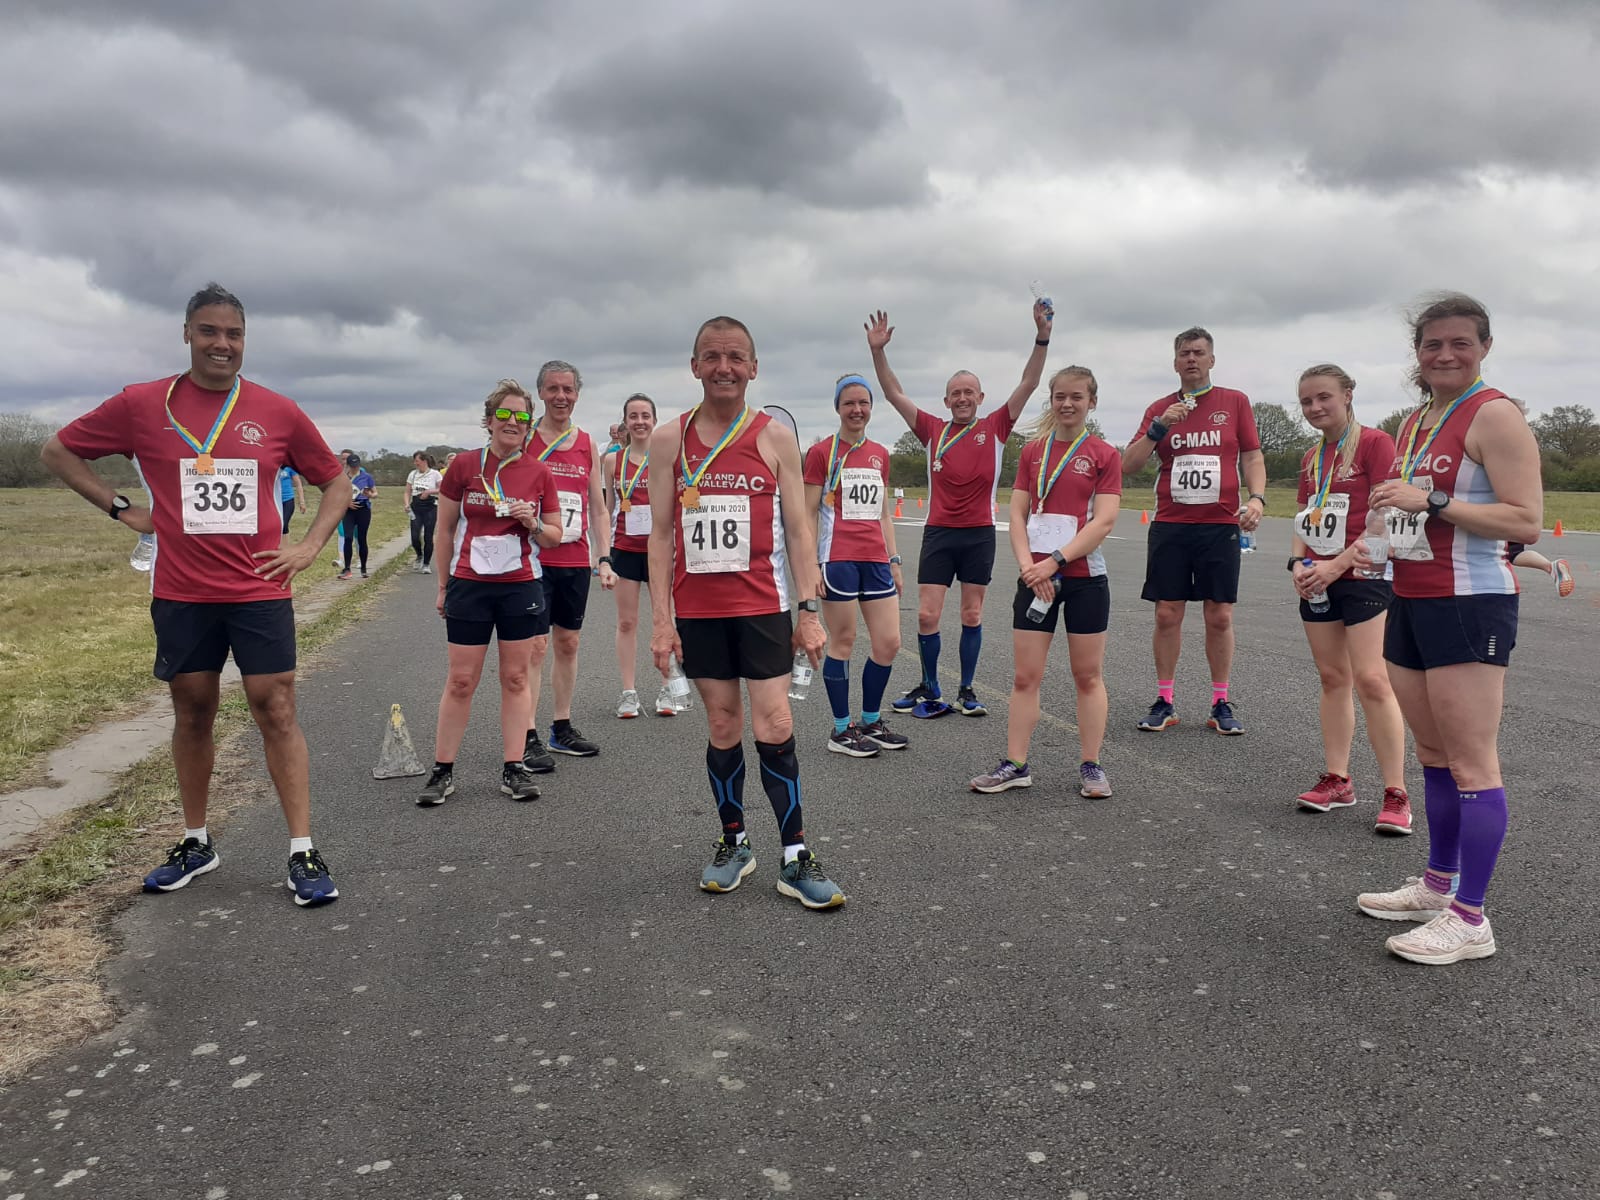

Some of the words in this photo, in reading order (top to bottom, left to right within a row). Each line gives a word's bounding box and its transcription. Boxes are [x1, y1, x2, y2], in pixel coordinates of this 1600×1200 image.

[1170, 430, 1221, 450] G-MAN
[185, 468, 215, 477] JIG
[217, 468, 234, 476] RUN
[235, 468, 255, 477] 2020
[714, 473, 735, 481] AND
[1178, 470, 1212, 490] 405
[698, 480, 735, 489] VALLEY
[733, 474, 766, 492] AC
[193, 481, 247, 512] 336
[848, 484, 878, 504] 402
[710, 504, 727, 513] RUN
[728, 504, 747, 513] 2020
[691, 518, 739, 551] 418
